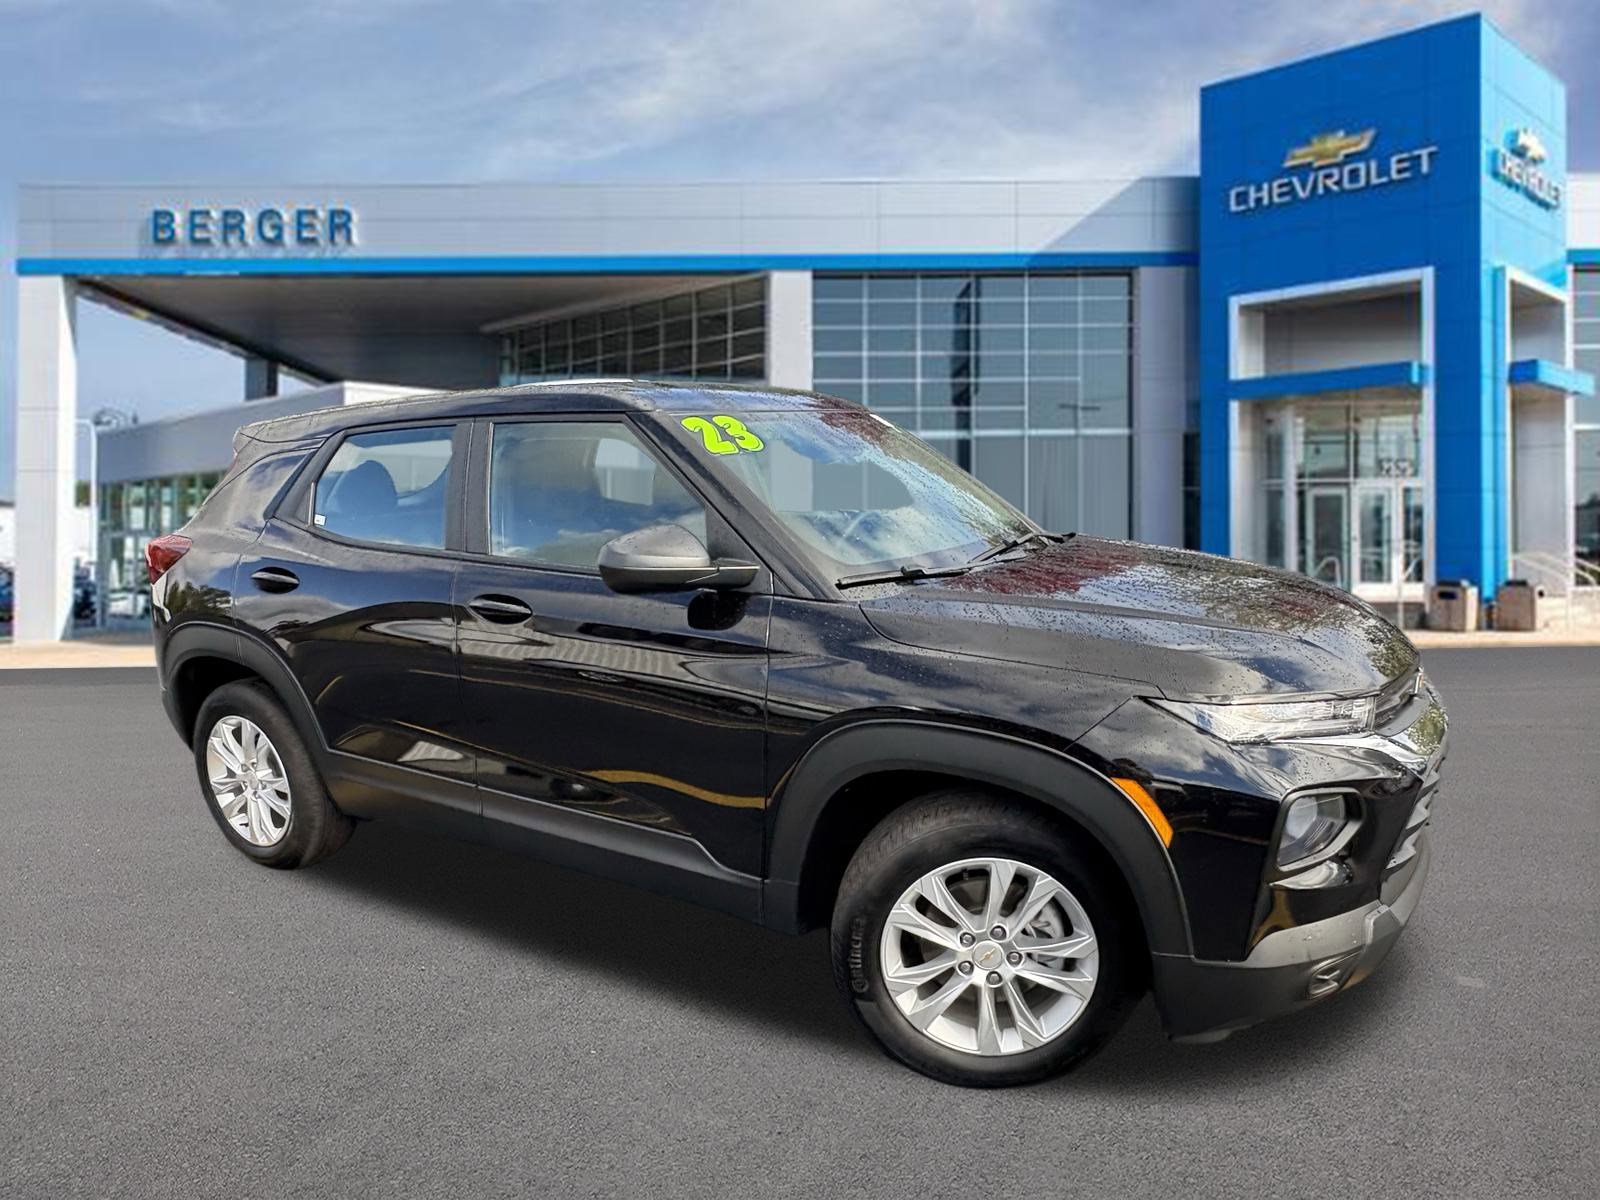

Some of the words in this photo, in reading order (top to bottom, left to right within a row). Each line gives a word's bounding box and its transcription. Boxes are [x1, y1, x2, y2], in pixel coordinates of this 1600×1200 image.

[1229, 146, 1438, 213] CHEVROLET
[152, 208, 354, 246] BERGER
[680, 415, 765, 455] 23
